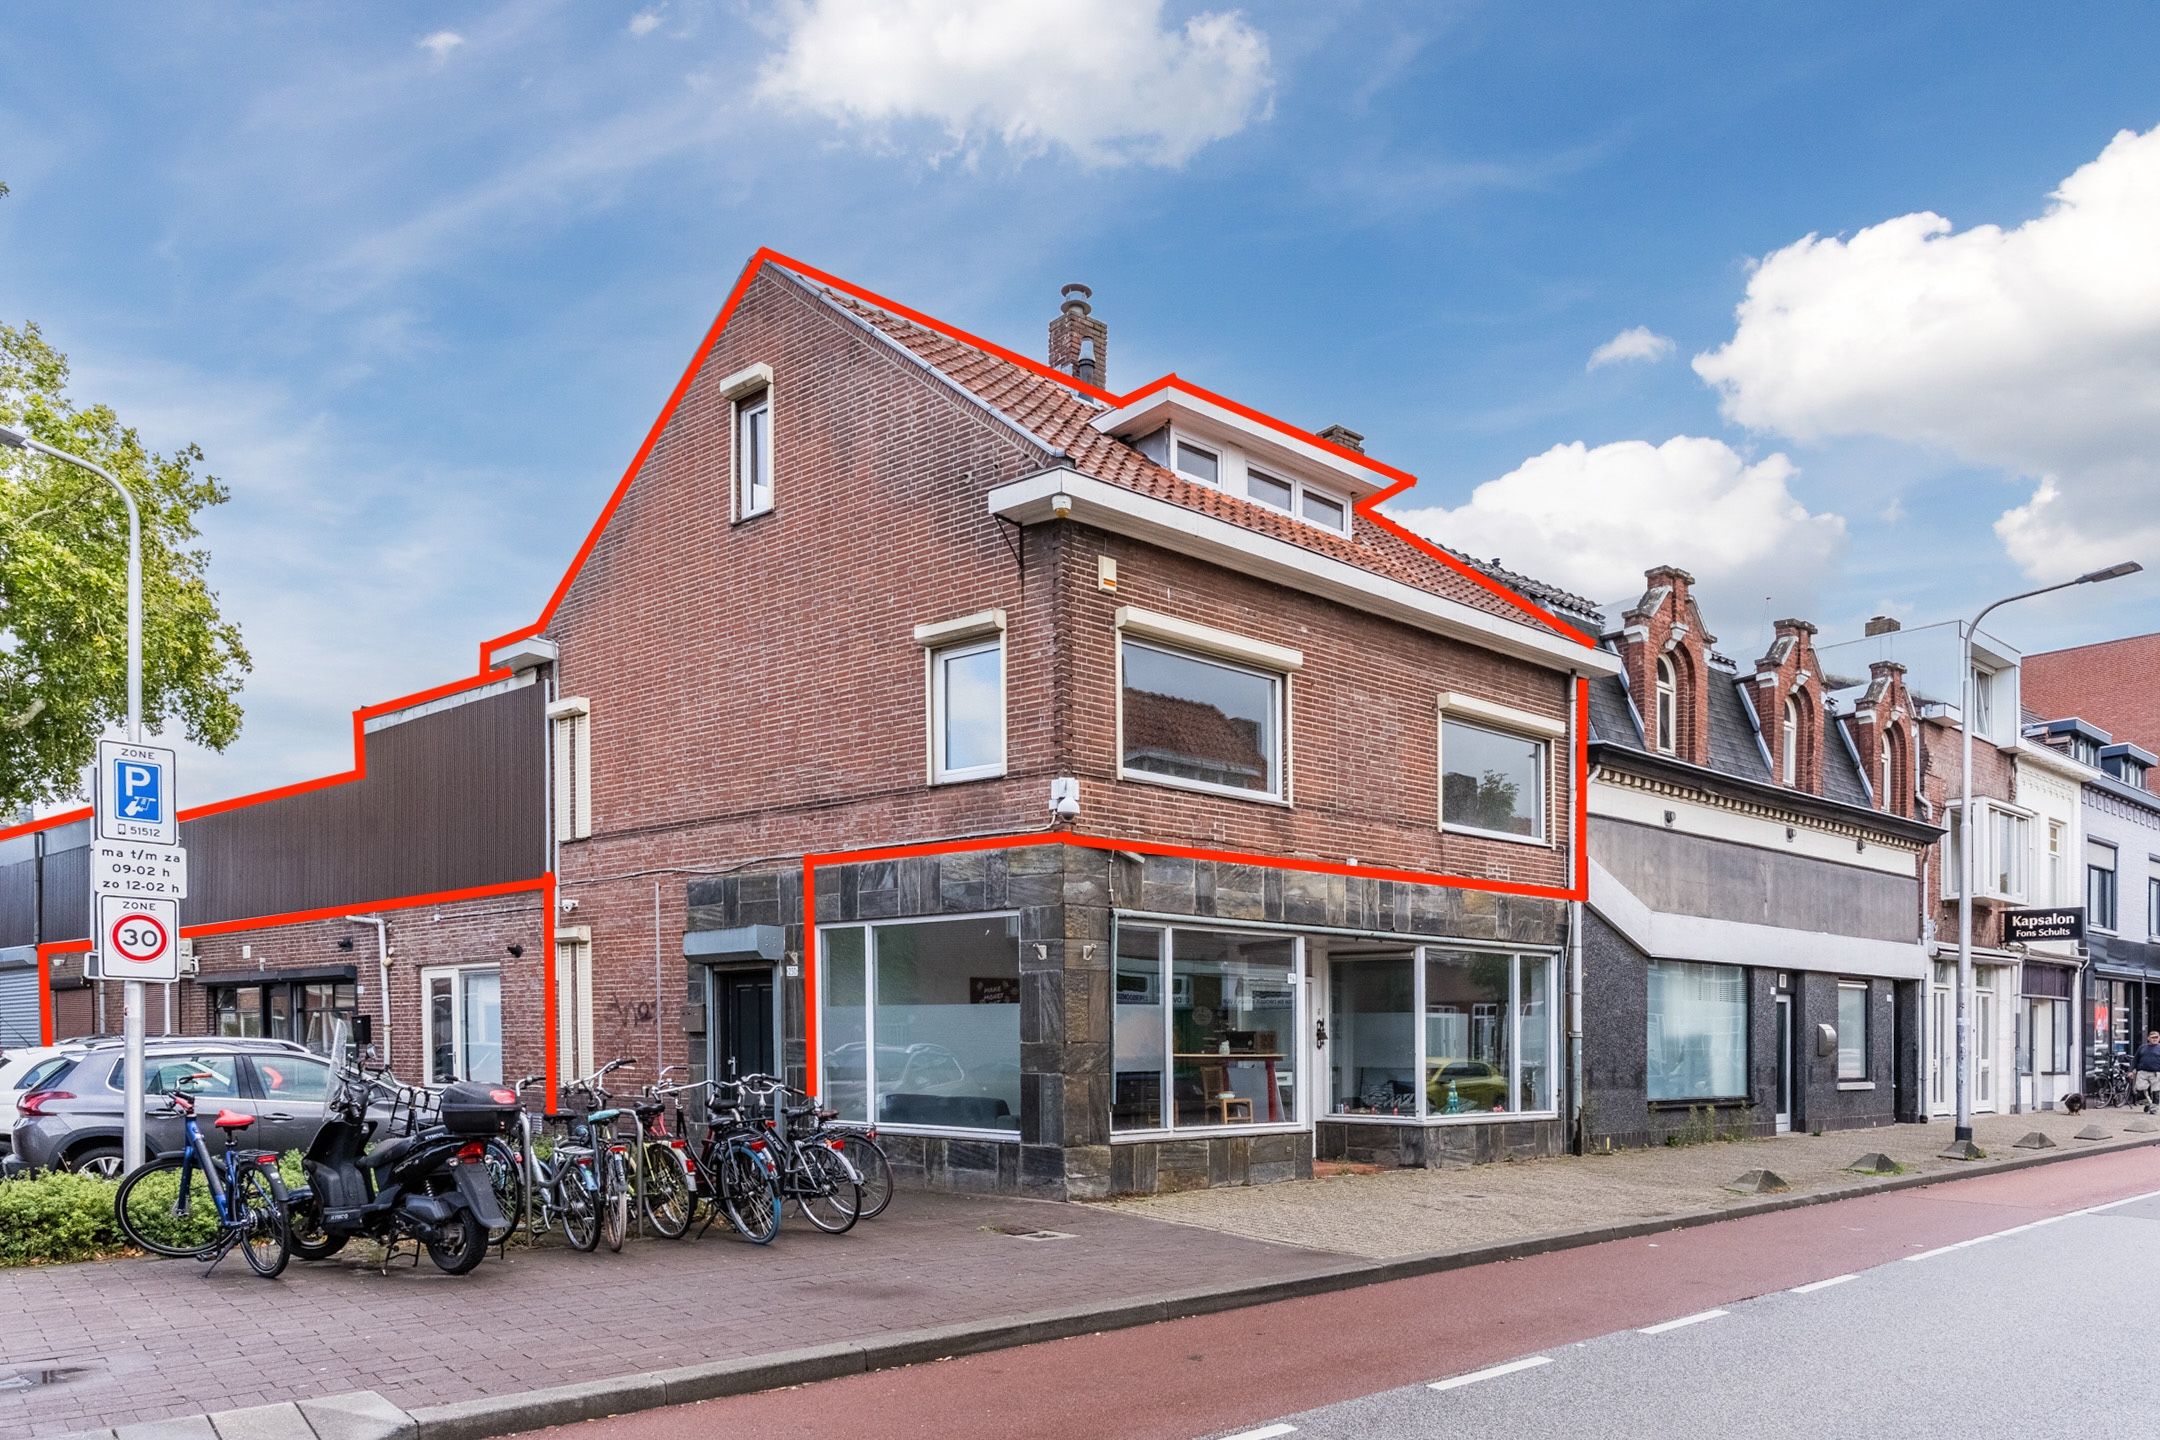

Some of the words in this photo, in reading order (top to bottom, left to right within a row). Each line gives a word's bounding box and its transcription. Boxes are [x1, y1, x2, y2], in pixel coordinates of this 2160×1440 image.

[121, 748, 155, 760] ZONE
[125, 766, 151, 797] P
[130, 827, 161, 837] 51512
[101, 848, 124, 858] ma
[131, 849, 157, 860] t/m
[164, 854, 180, 863] za
[112, 864, 156, 876] 09-02
[162, 868, 170, 877] h
[126, 881, 165, 892] 12-02
[171, 884, 179, 893] h
[123, 902, 156, 911] ZONE
[2012, 913, 2075, 929] Kapsalon
[122, 929, 158, 947] 30
[2016, 929, 2037, 937] Fons
[2038, 928, 2070, 936] Schults
